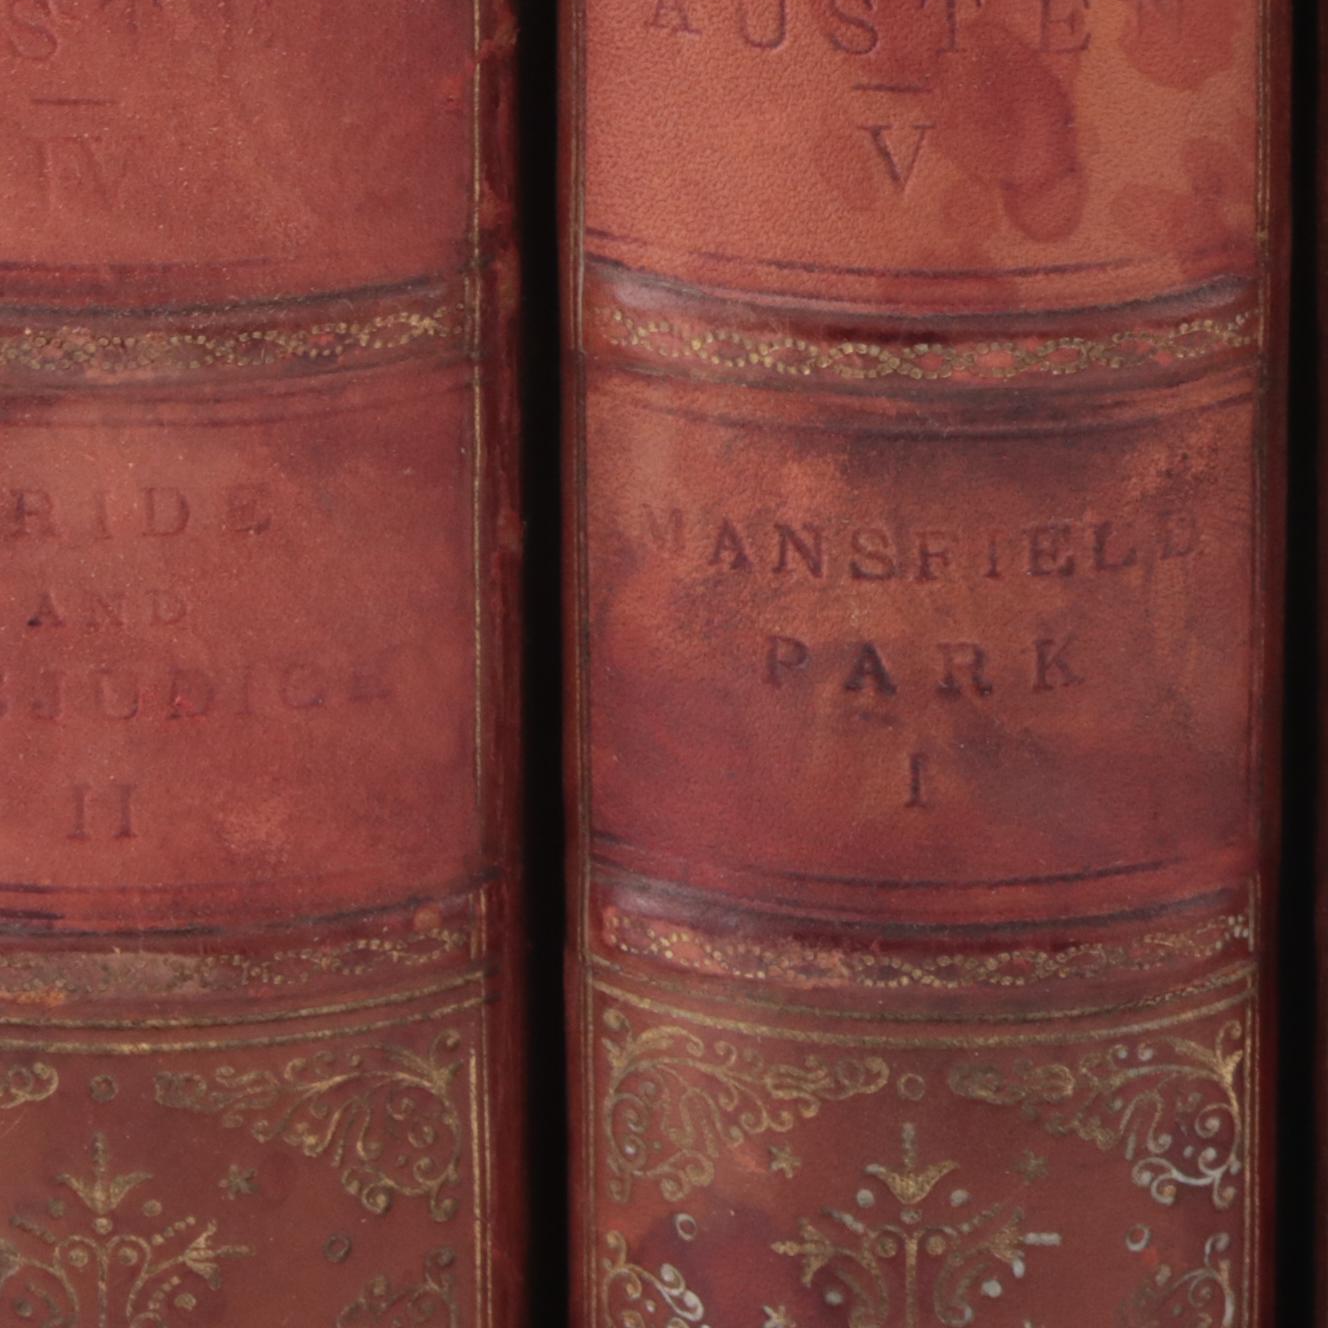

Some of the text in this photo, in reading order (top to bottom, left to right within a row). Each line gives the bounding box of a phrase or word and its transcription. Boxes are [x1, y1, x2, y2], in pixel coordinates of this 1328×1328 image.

[858, 123, 936, 195] V
[640, 501, 1202, 584] MANSFIELD
[763, 635, 1085, 699] PARK
[903, 751, 929, 810] I
[66, 784, 138, 843] II
